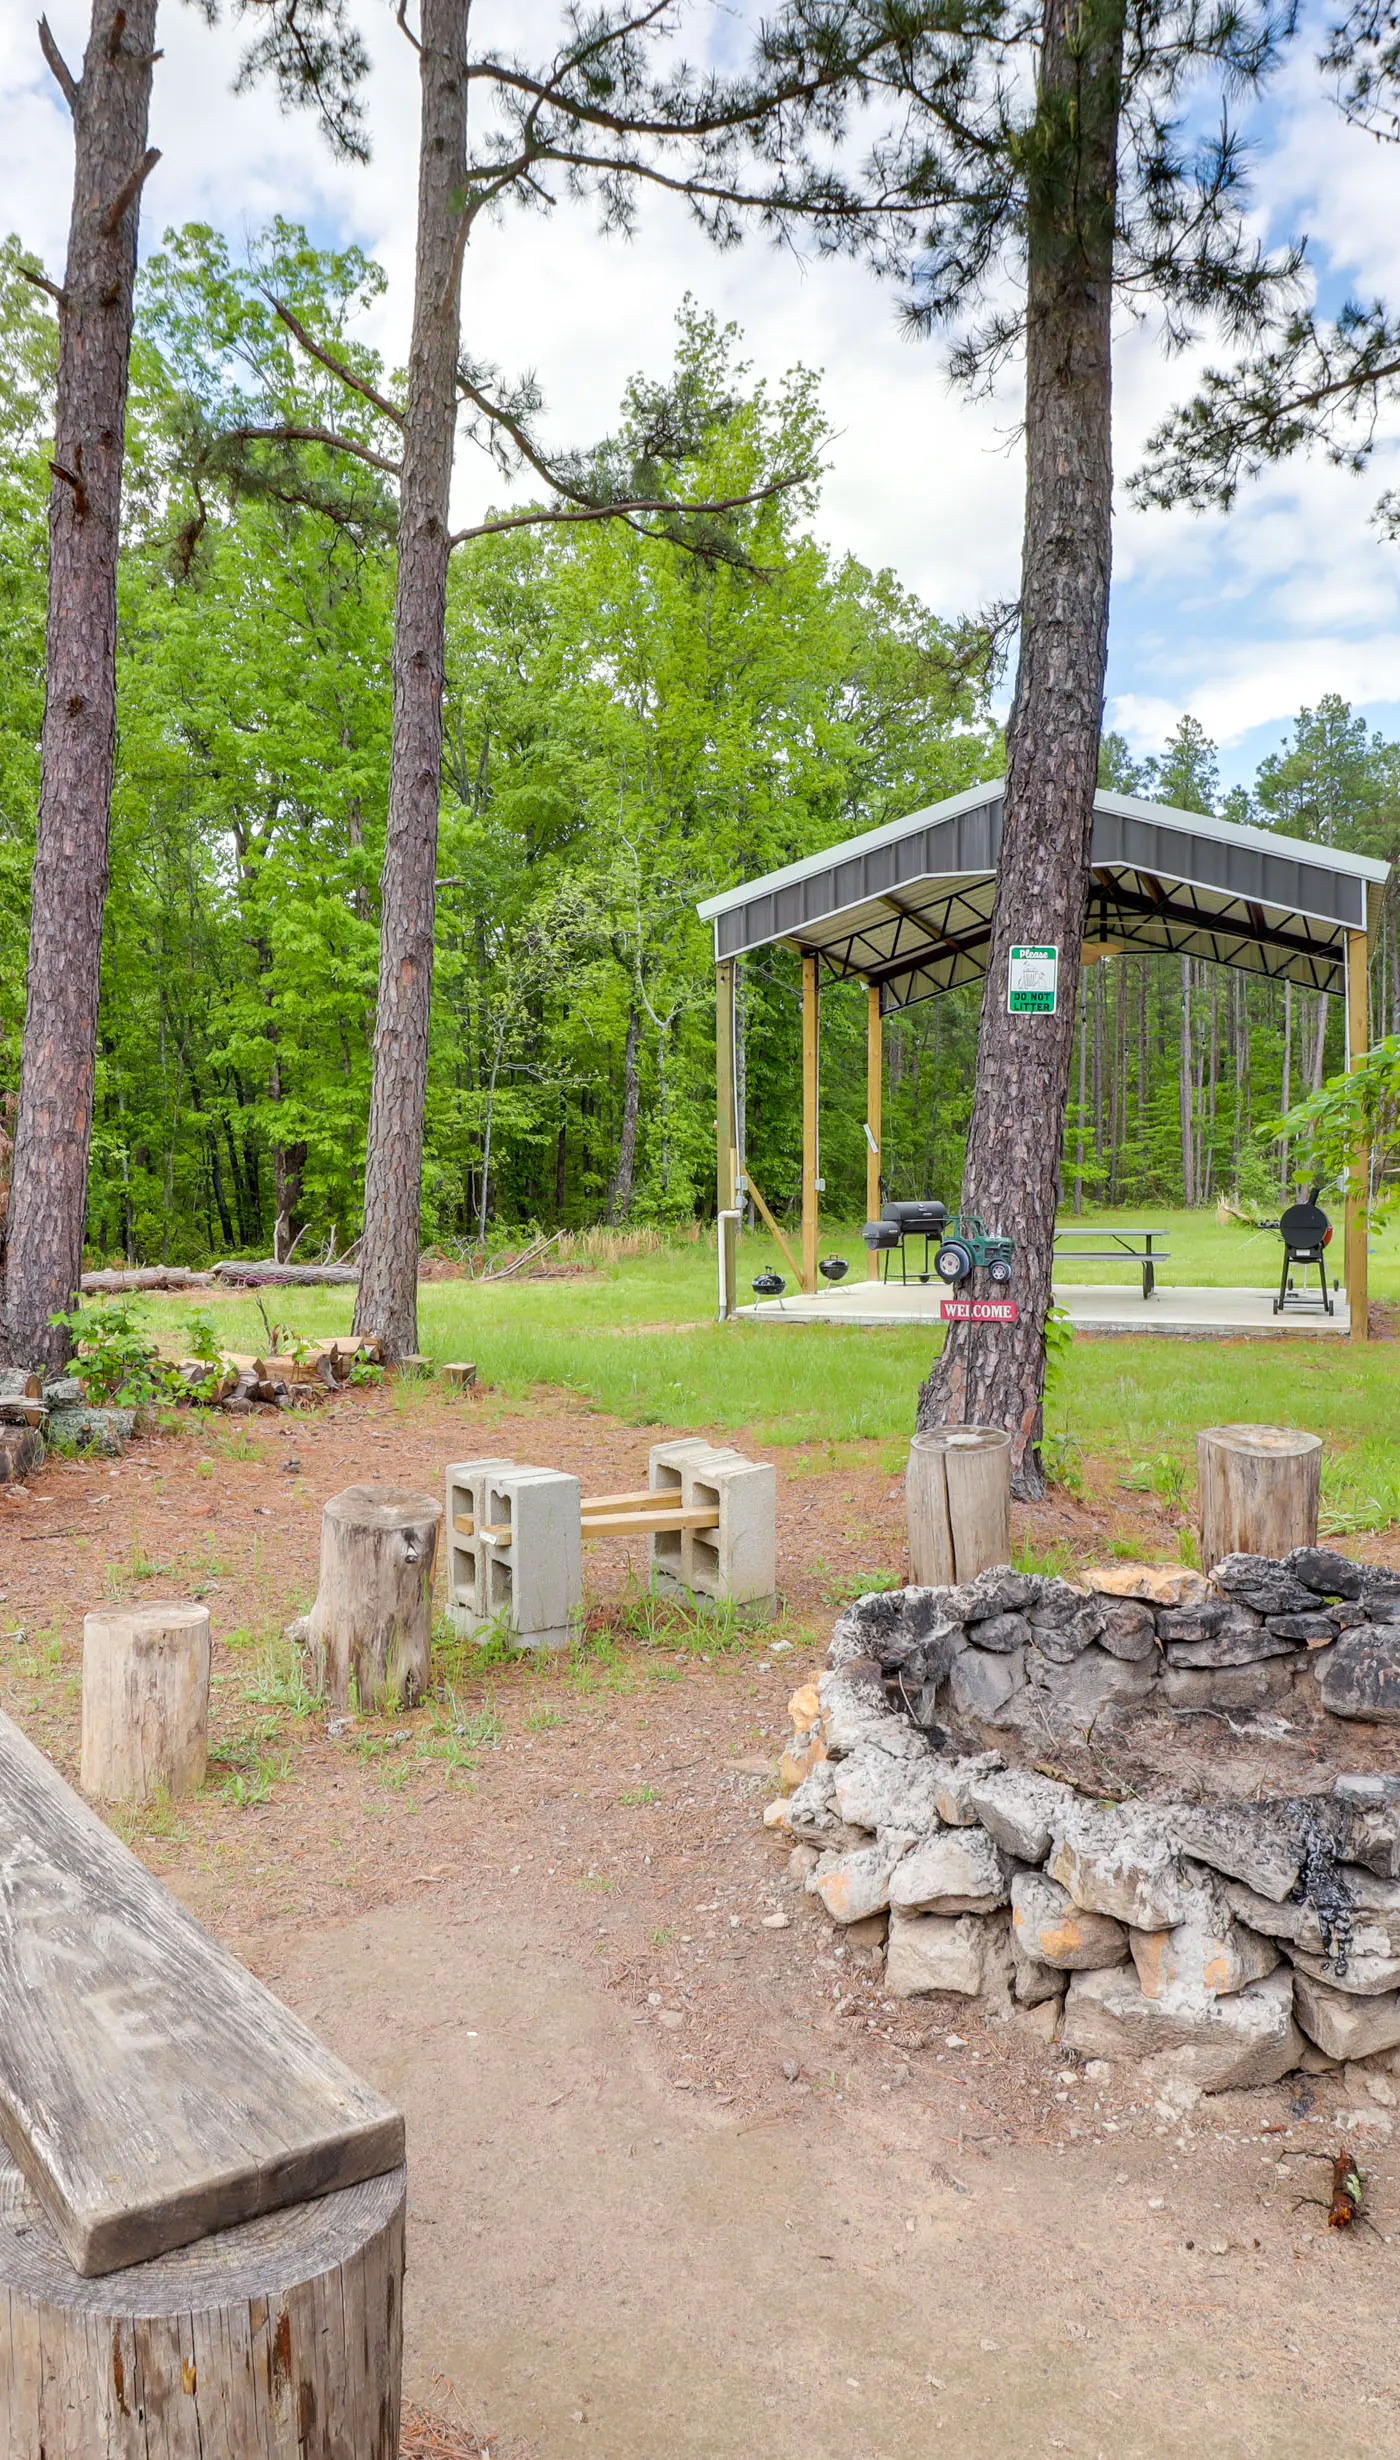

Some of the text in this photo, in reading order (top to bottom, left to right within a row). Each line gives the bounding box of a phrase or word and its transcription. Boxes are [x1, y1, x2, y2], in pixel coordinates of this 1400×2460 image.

[1019, 949, 1048, 959] Please
[1014, 1003, 1049, 1011] LITTER
[944, 1304, 1012, 1318] WELCOME
